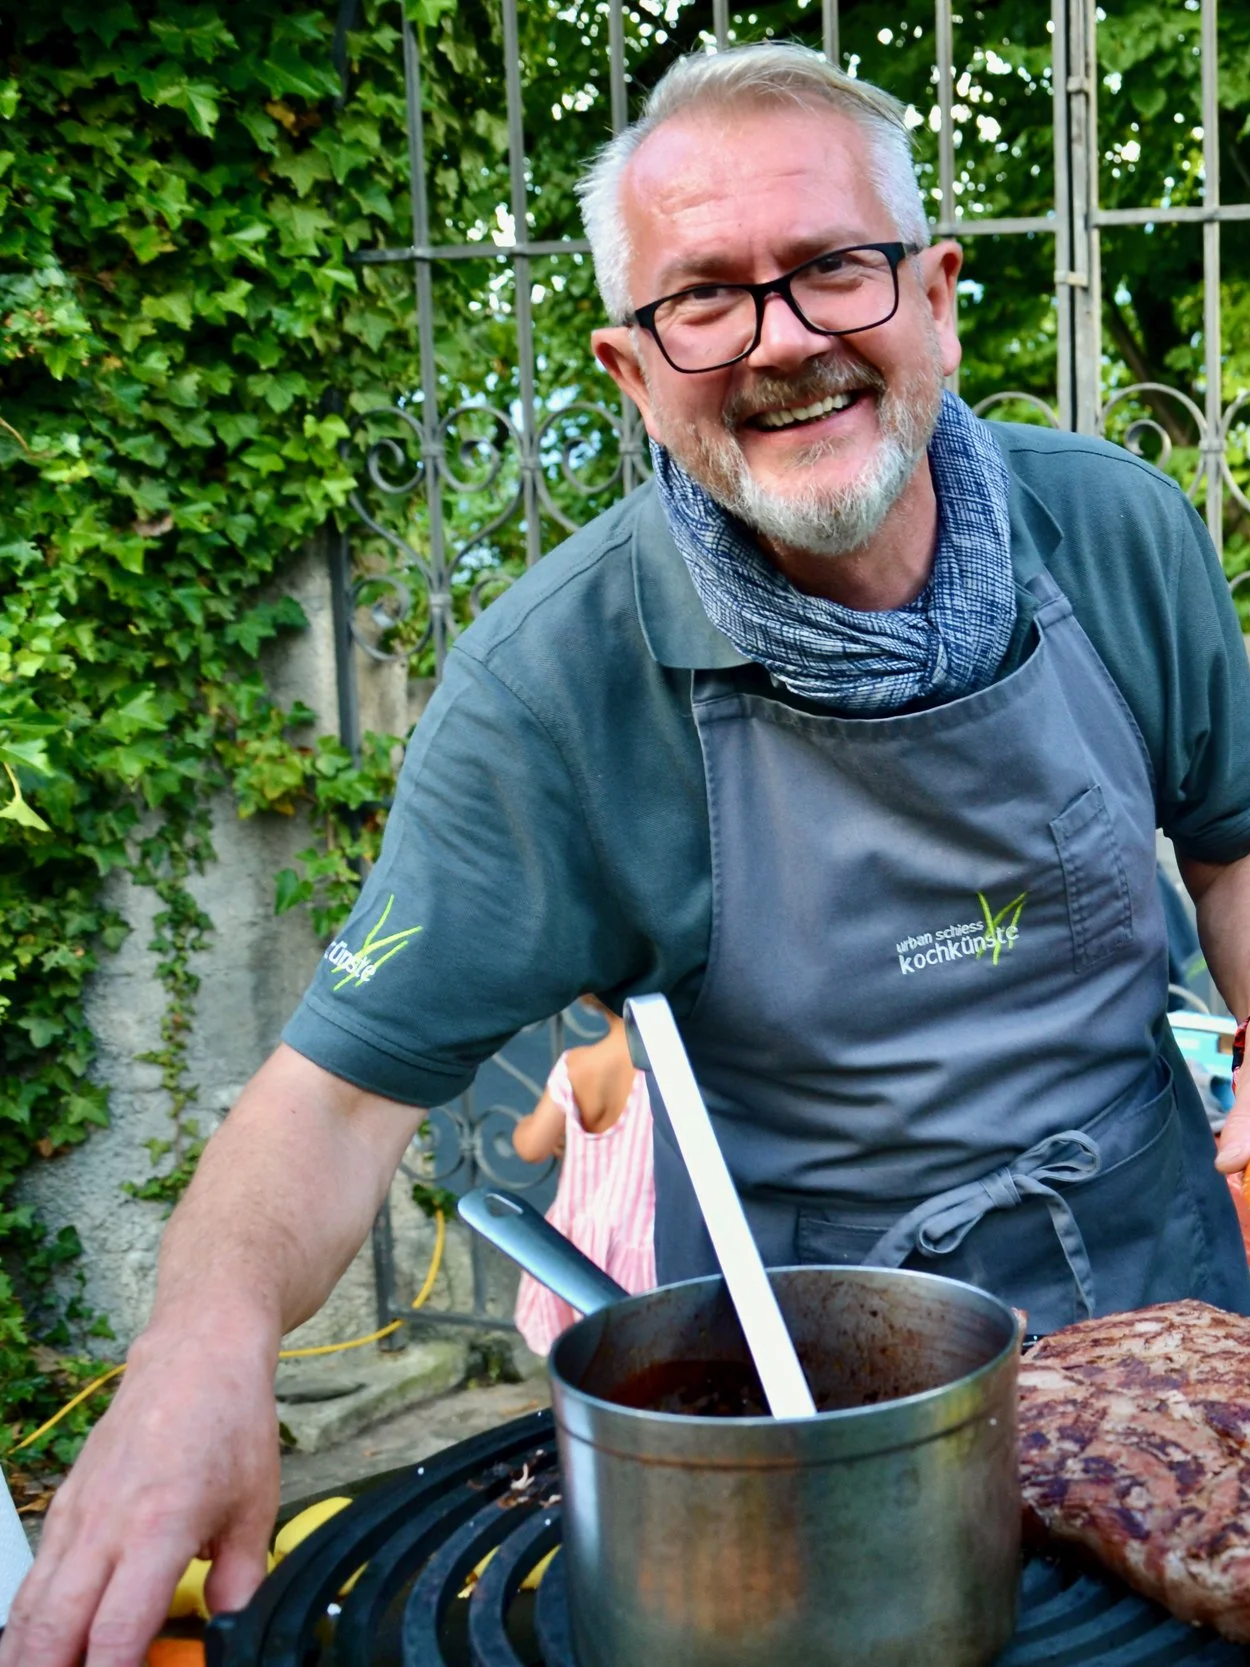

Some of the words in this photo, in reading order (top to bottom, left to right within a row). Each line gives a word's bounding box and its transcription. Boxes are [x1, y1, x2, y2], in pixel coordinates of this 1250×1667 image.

[896, 932, 933, 953] urban
[935, 920, 985, 941] schiess
[898, 925, 1020, 975] kochkünste
